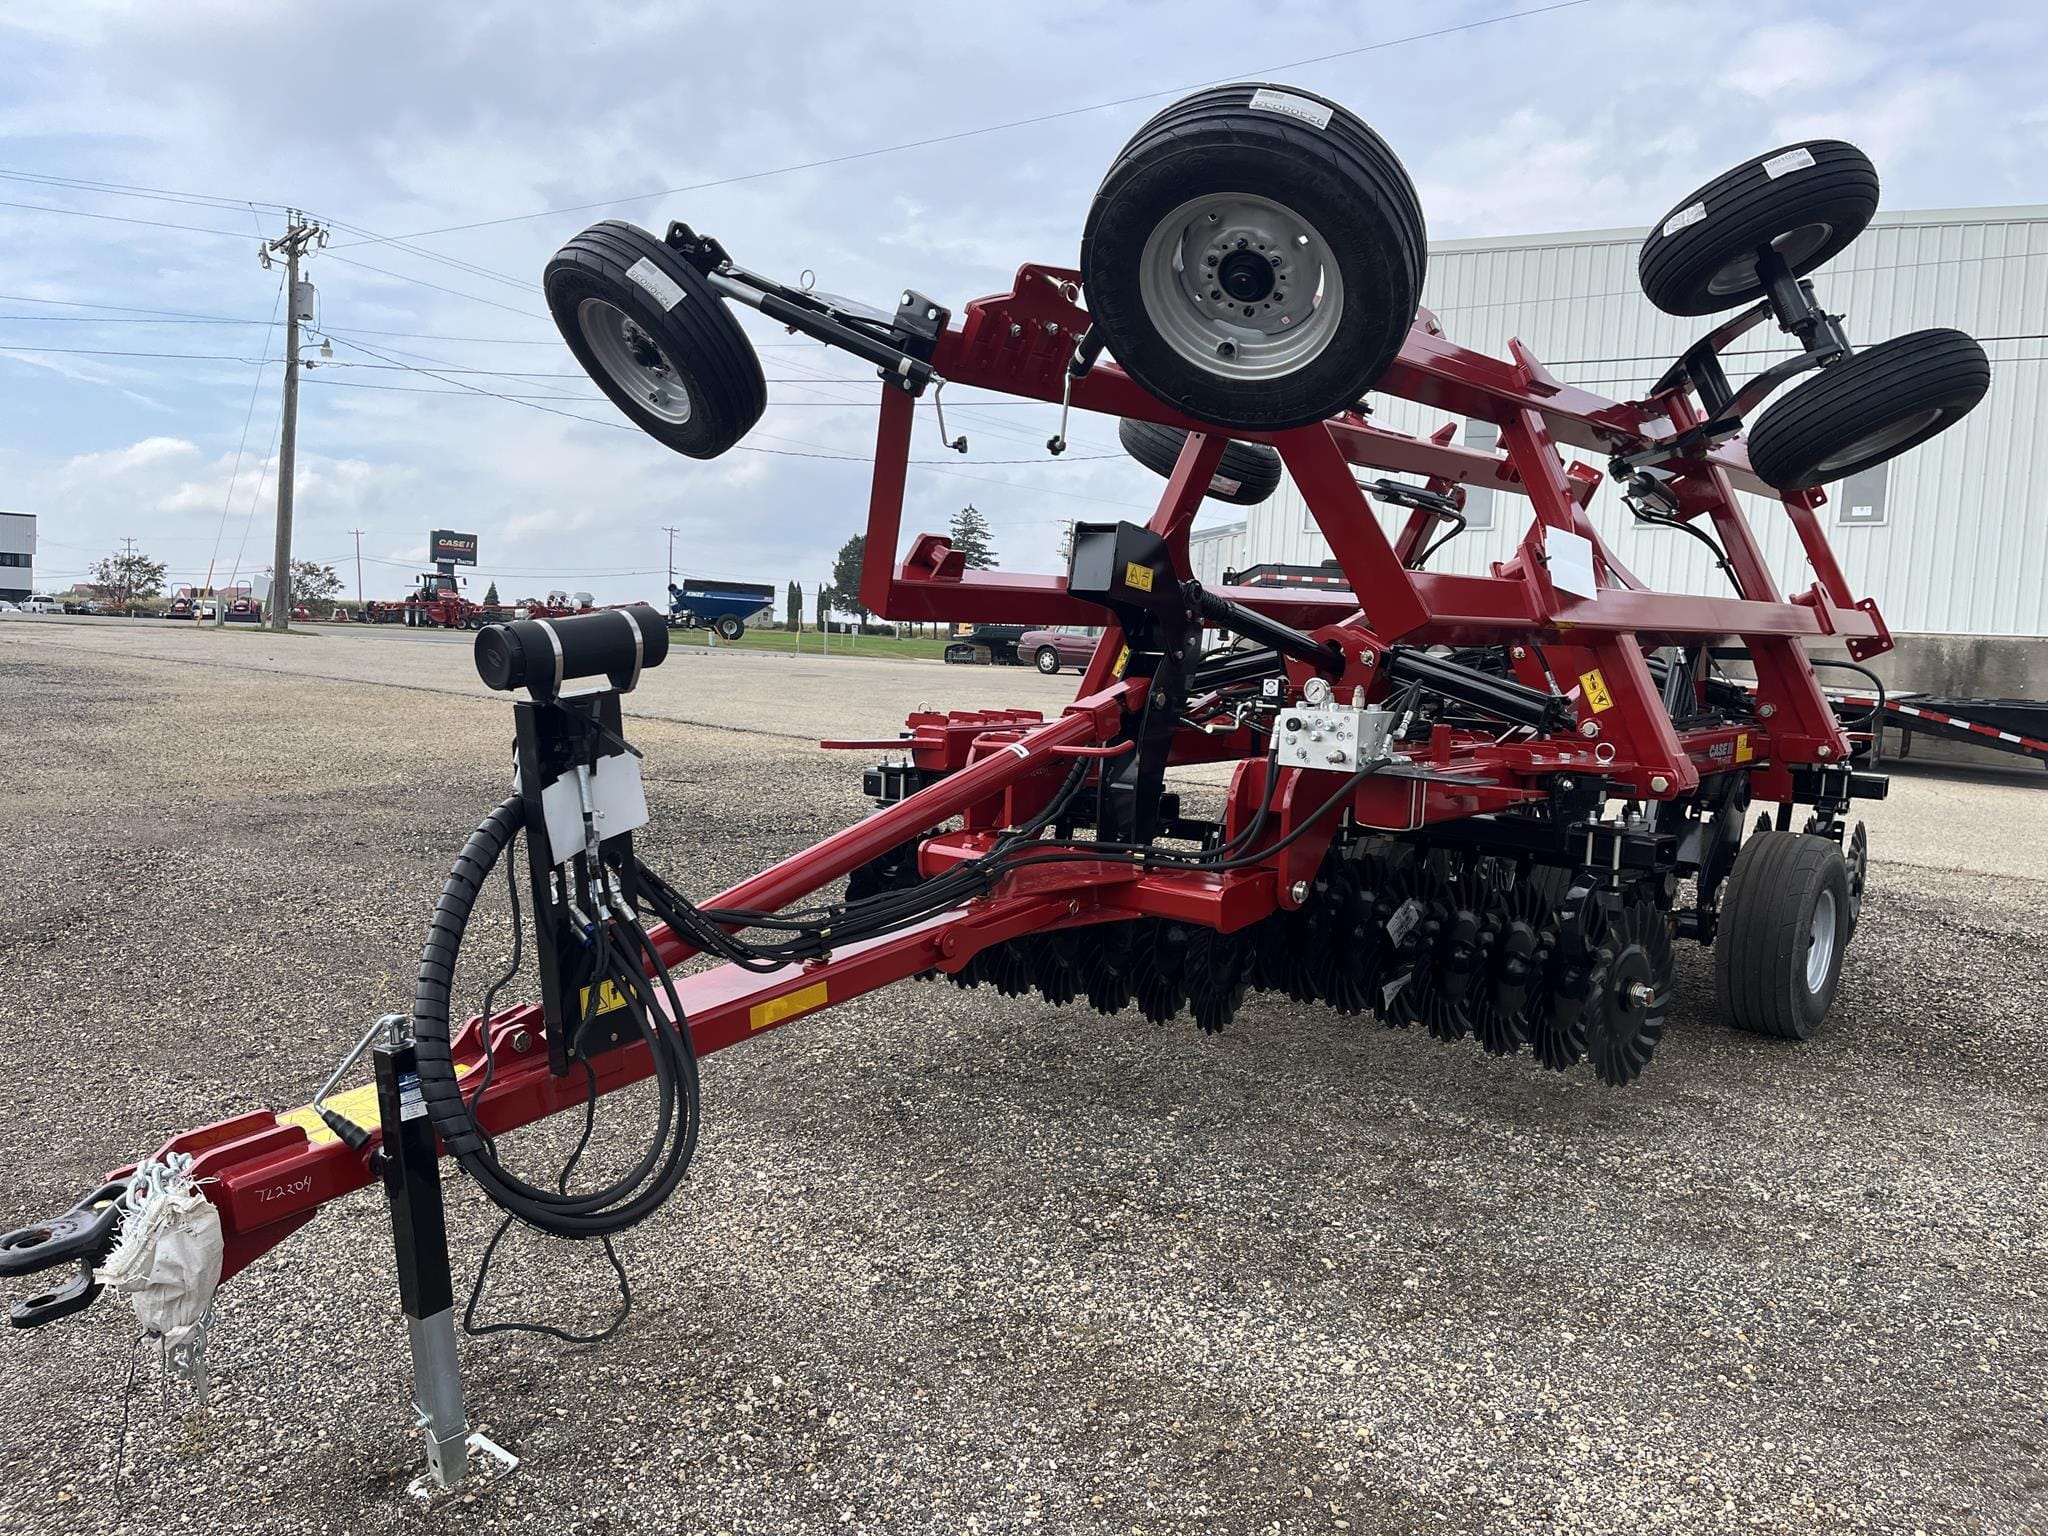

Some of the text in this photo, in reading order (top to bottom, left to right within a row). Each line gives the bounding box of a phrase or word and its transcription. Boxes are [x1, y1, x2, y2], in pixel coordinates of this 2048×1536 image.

[439, 539, 465, 548] CASE
[1709, 743, 1729, 758] CASE
[255, 1175, 312, 1203] TL2204
